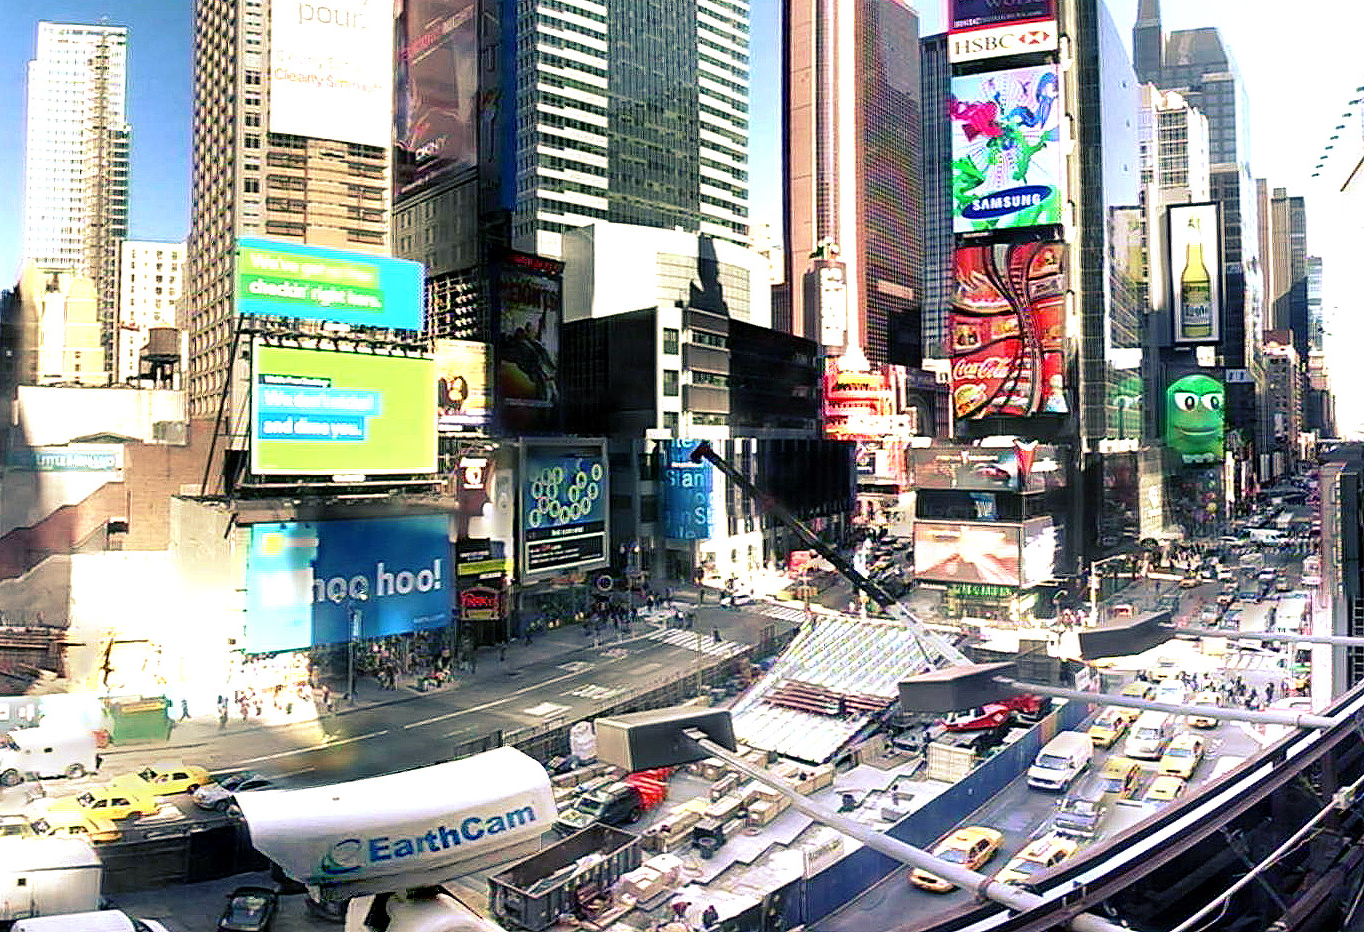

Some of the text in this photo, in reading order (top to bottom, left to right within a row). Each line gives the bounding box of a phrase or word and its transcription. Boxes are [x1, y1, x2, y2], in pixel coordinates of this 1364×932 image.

[954, 33, 1016, 56] HSBC
[972, 193, 1041, 211] SAMSUNG
[376, 558, 442, 595] hoo!
[368, 804, 537, 863] EarthCam
